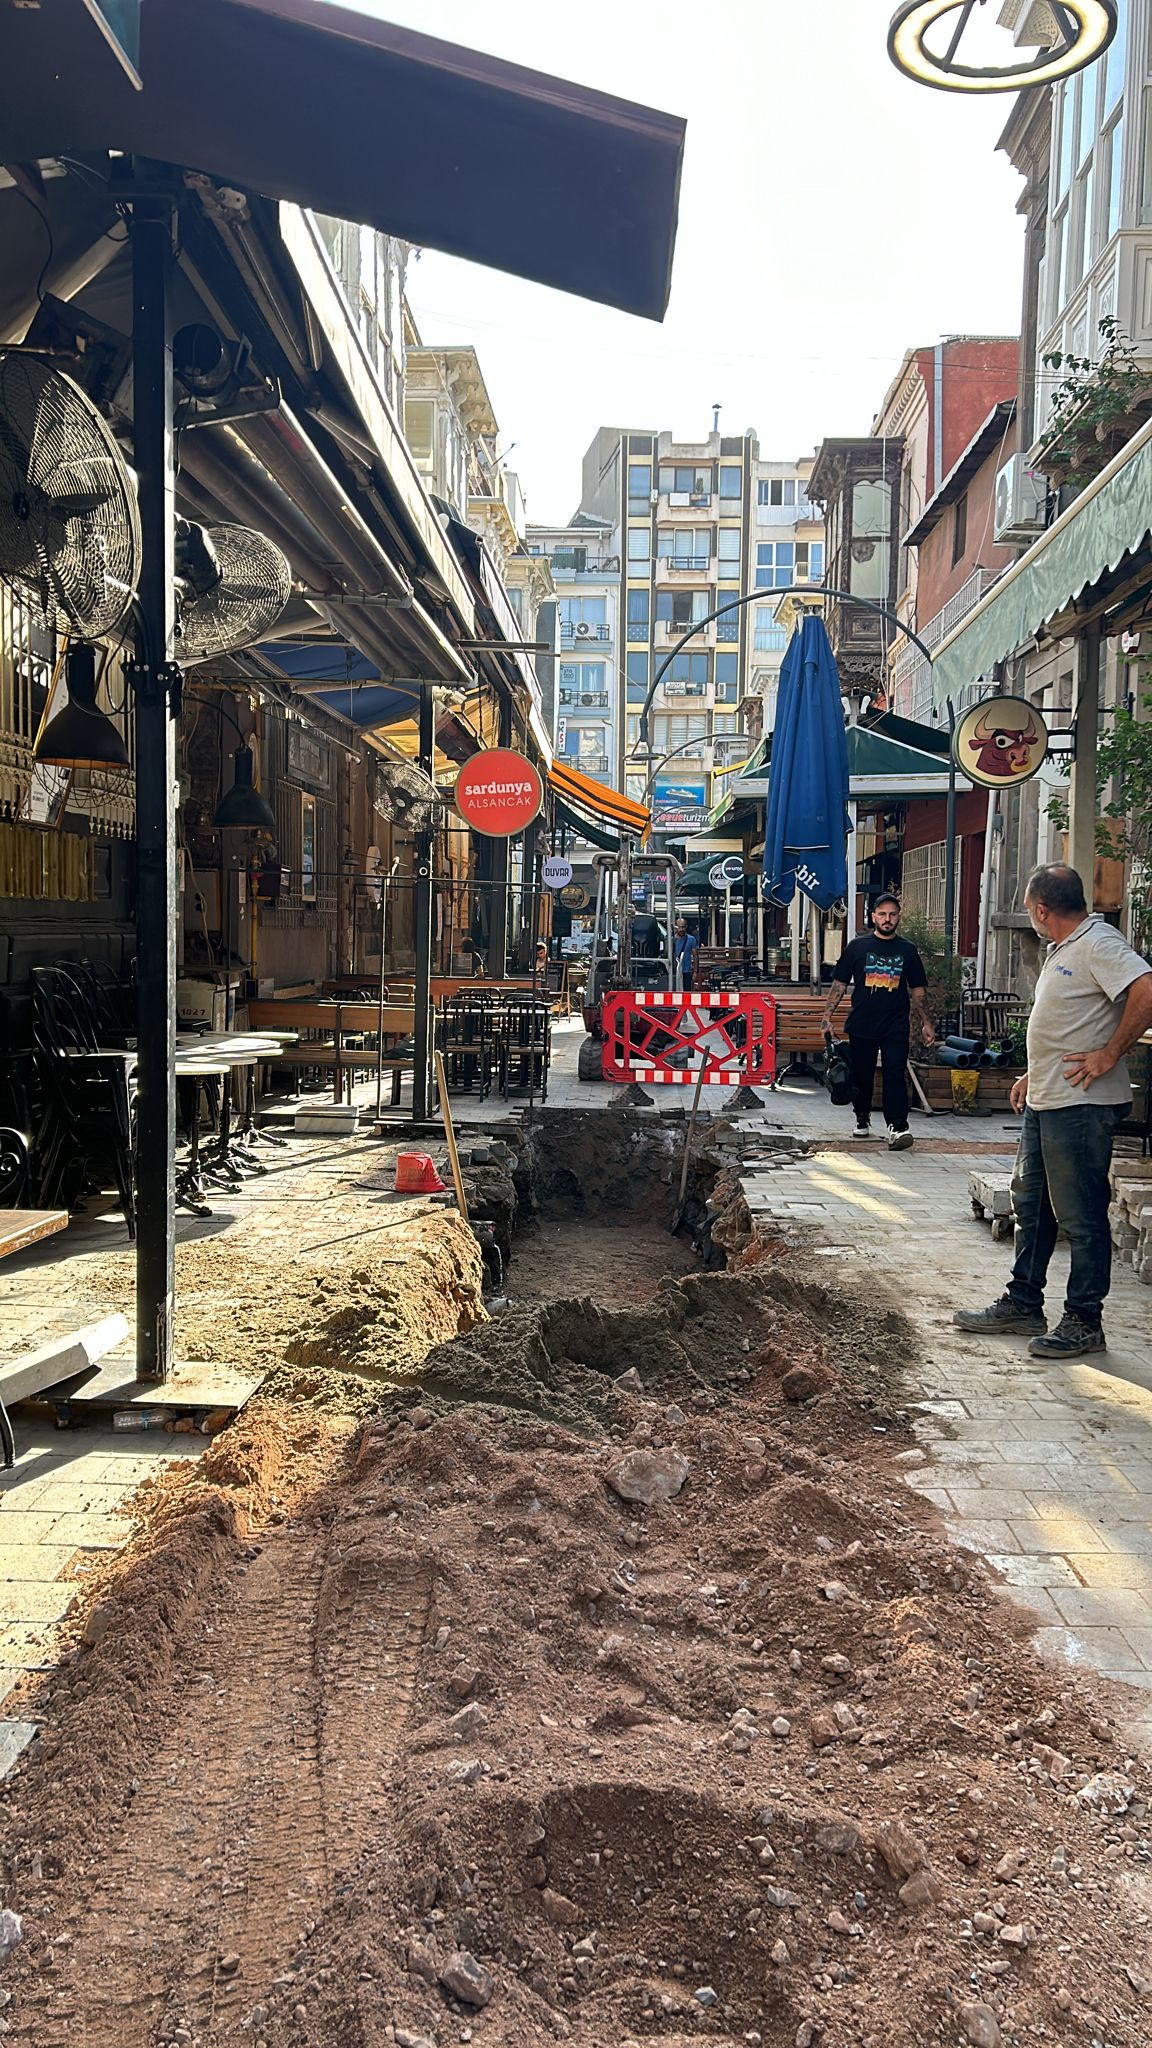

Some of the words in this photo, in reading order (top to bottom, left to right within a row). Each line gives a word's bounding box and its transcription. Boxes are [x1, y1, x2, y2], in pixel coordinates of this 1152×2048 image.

[465, 781, 532, 796] sardunya
[468, 796, 532, 809] ALSANCAK
[545, 867, 570, 877] DUVAR
[180, 1007, 206, 1016] 1027
